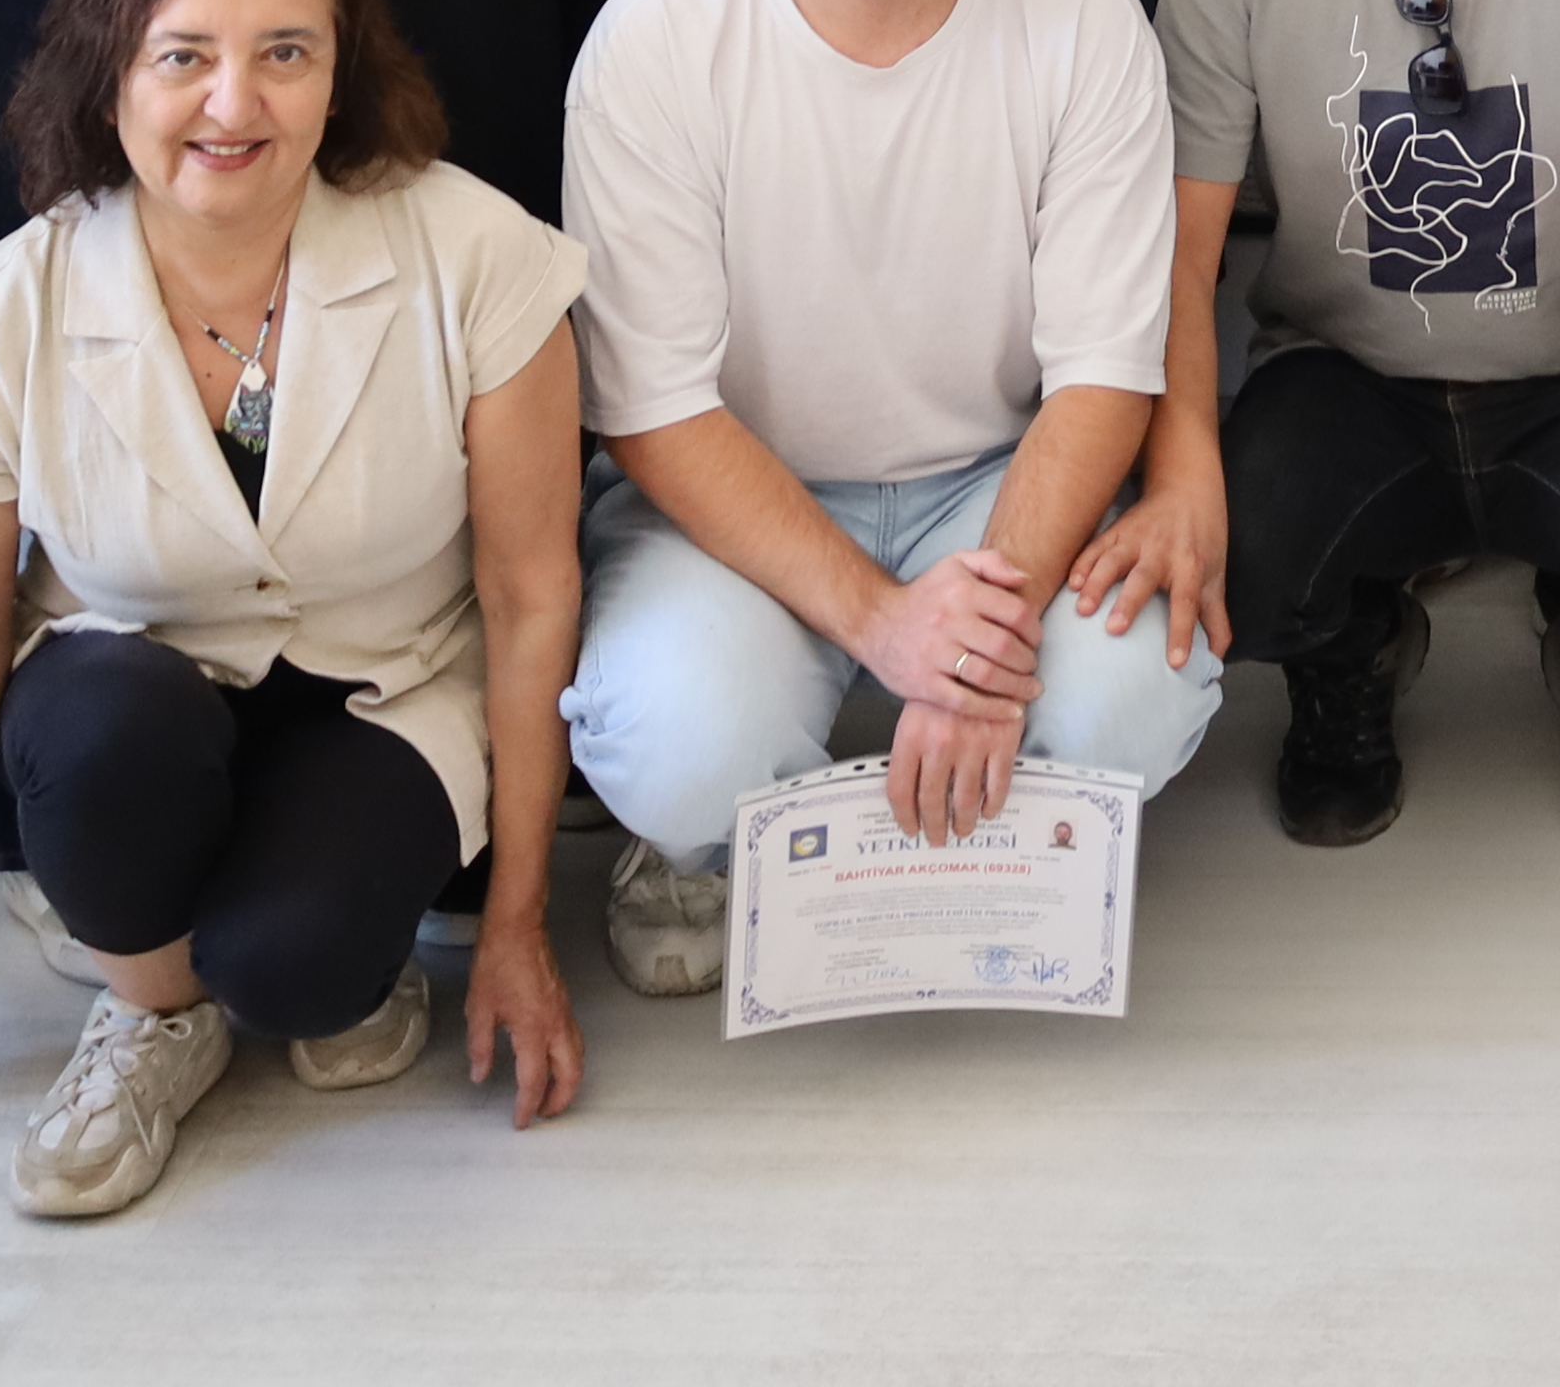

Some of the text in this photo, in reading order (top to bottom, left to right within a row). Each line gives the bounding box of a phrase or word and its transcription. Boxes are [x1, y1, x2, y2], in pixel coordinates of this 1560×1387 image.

[856, 835, 921, 856] YETKİ
[834, 863, 905, 883] BAHTİYAR
[907, 861, 980, 878] AKÇOMAK
